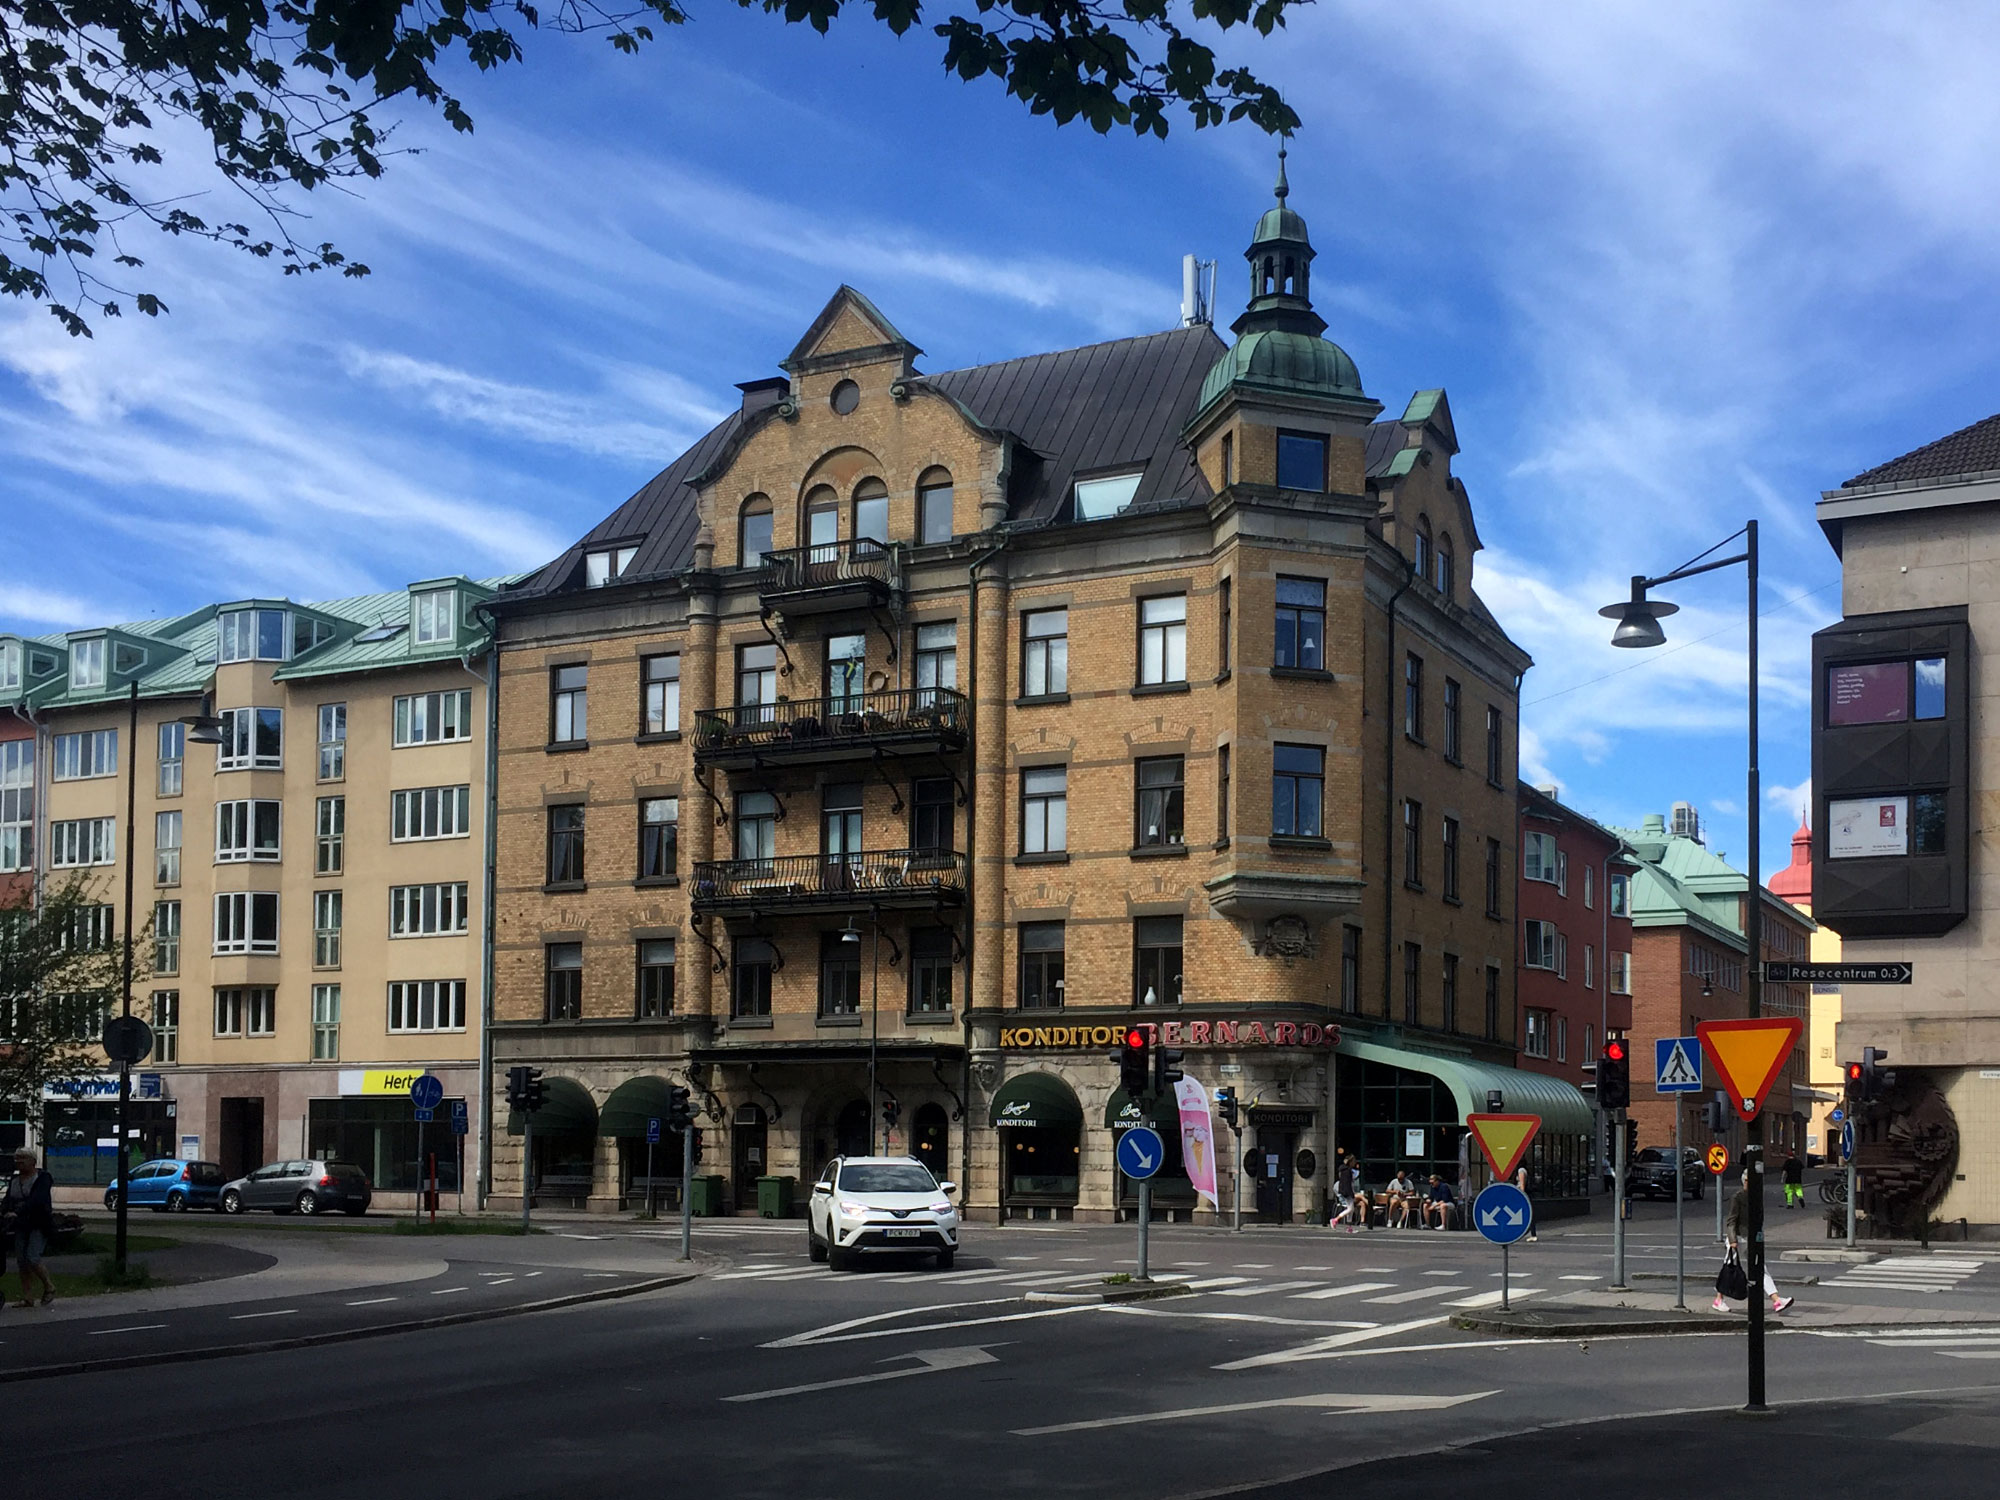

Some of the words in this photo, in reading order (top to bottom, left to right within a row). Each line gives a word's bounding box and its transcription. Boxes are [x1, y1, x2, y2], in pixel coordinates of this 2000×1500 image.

[1792, 967, 1877, 979] Resecentrum
[1000, 1025, 1128, 1047] KONDITOR
[455, 1103, 464, 1116] P
[996, 1119, 1037, 1127] KONDITORI
[1253, 1113, 1309, 1124] KONDITORI
[650, 1120, 658, 1133] P
[1114, 1121, 1156, 1129] KONDITI
